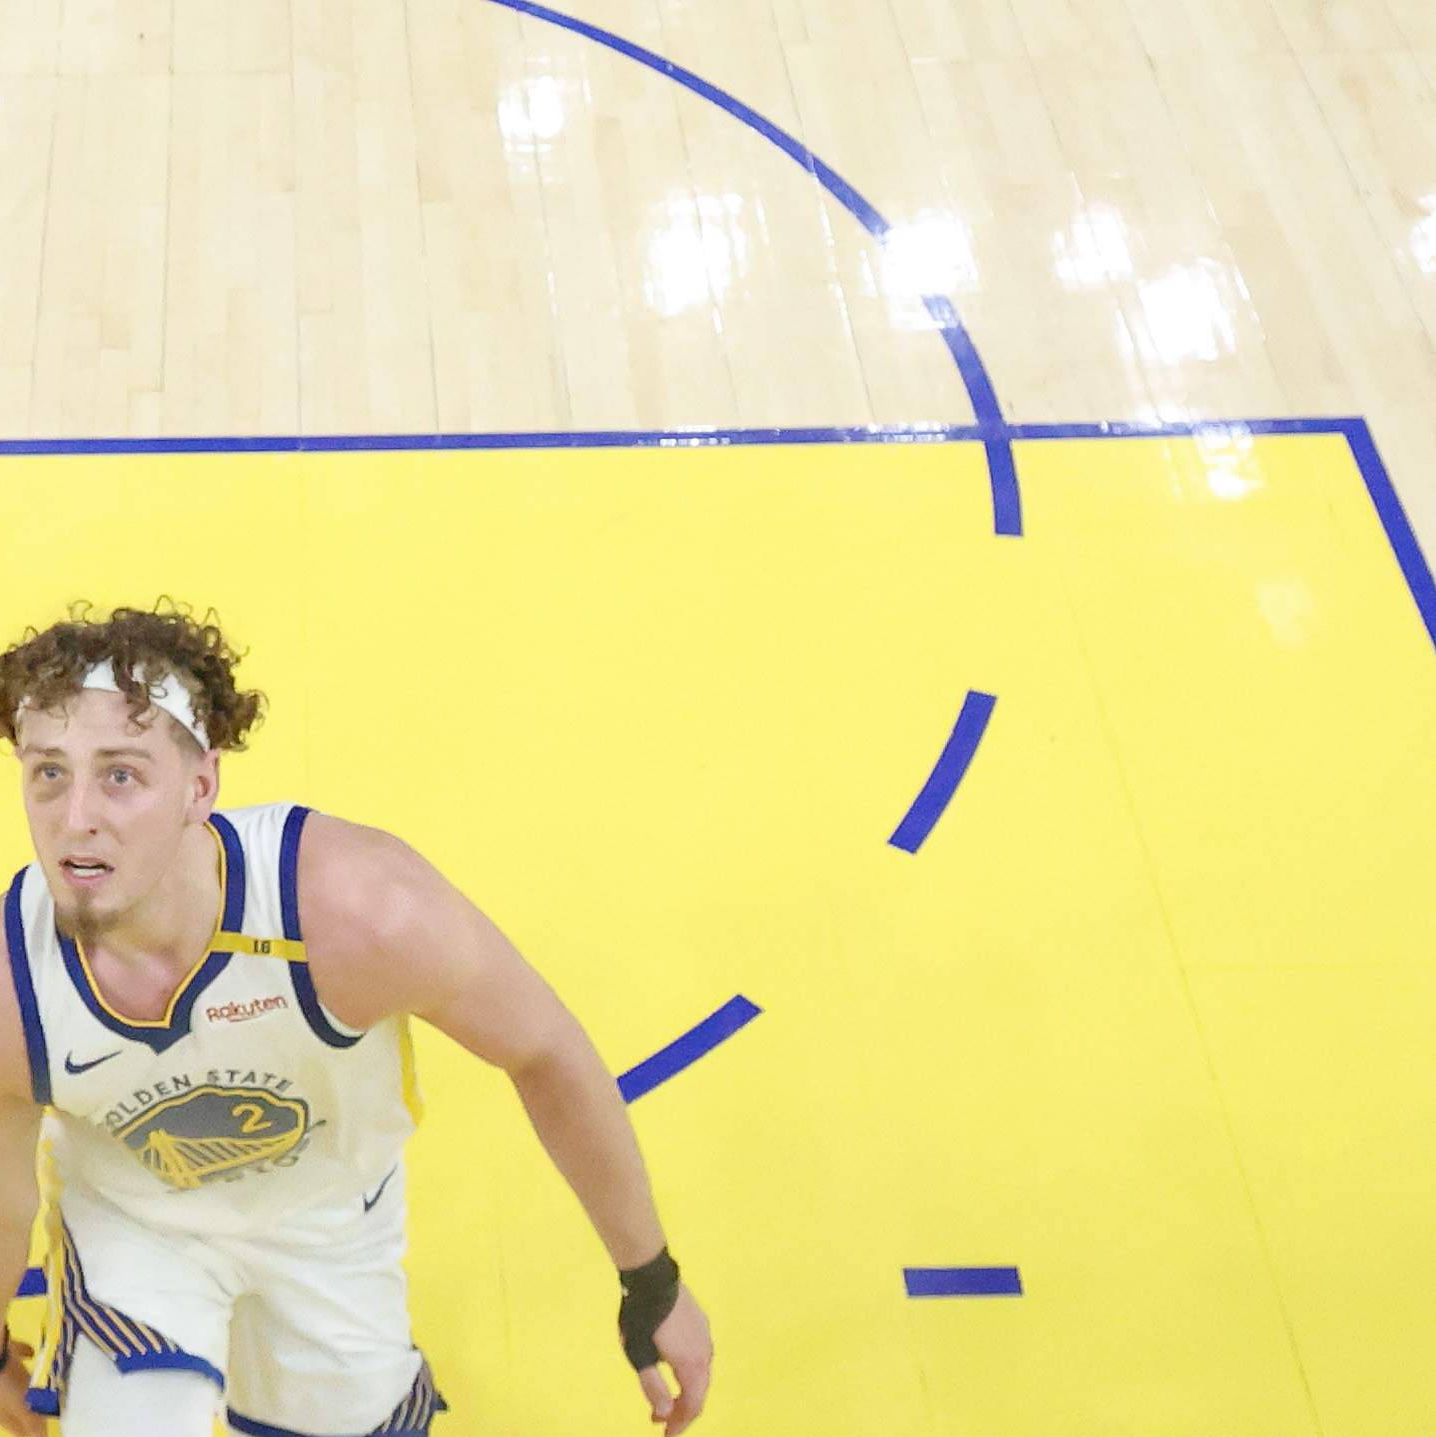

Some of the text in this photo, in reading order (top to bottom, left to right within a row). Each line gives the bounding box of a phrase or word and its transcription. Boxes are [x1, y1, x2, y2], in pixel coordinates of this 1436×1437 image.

[205, 995, 288, 1022] Rakuten
[98, 1069, 294, 1128] OLDEN STATE
[231, 1103, 272, 1133] 2
